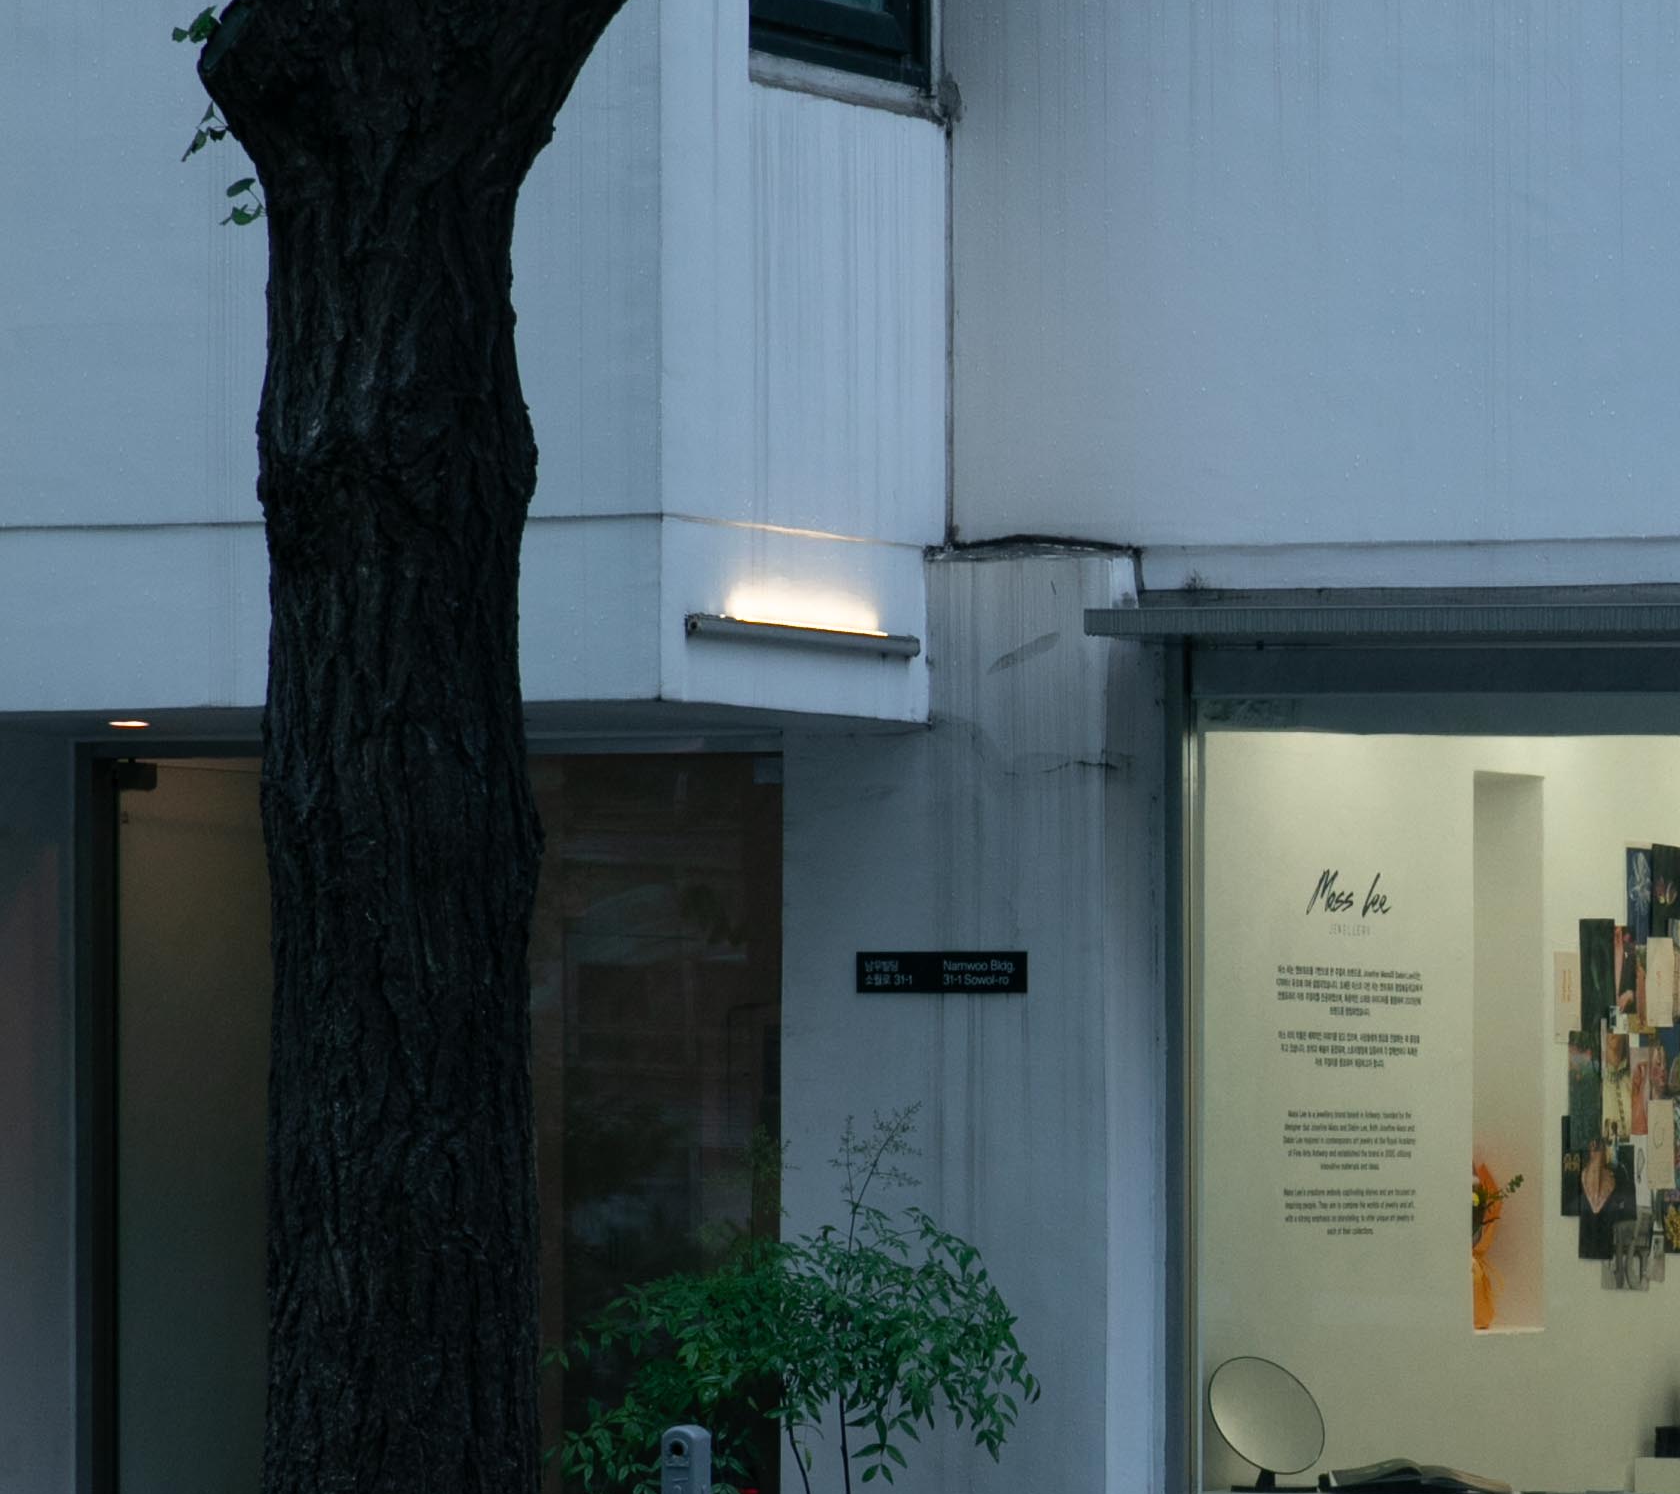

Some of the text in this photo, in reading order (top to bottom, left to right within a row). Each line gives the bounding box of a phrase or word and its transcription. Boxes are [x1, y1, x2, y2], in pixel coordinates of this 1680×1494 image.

[1306, 868, 1392, 919] Mass Lee
[943, 959, 1016, 974] Namwoo Bldg.
[893, 974, 913, 986] 31-1
[943, 974, 1010, 986] 31-1 Sowol-ro
